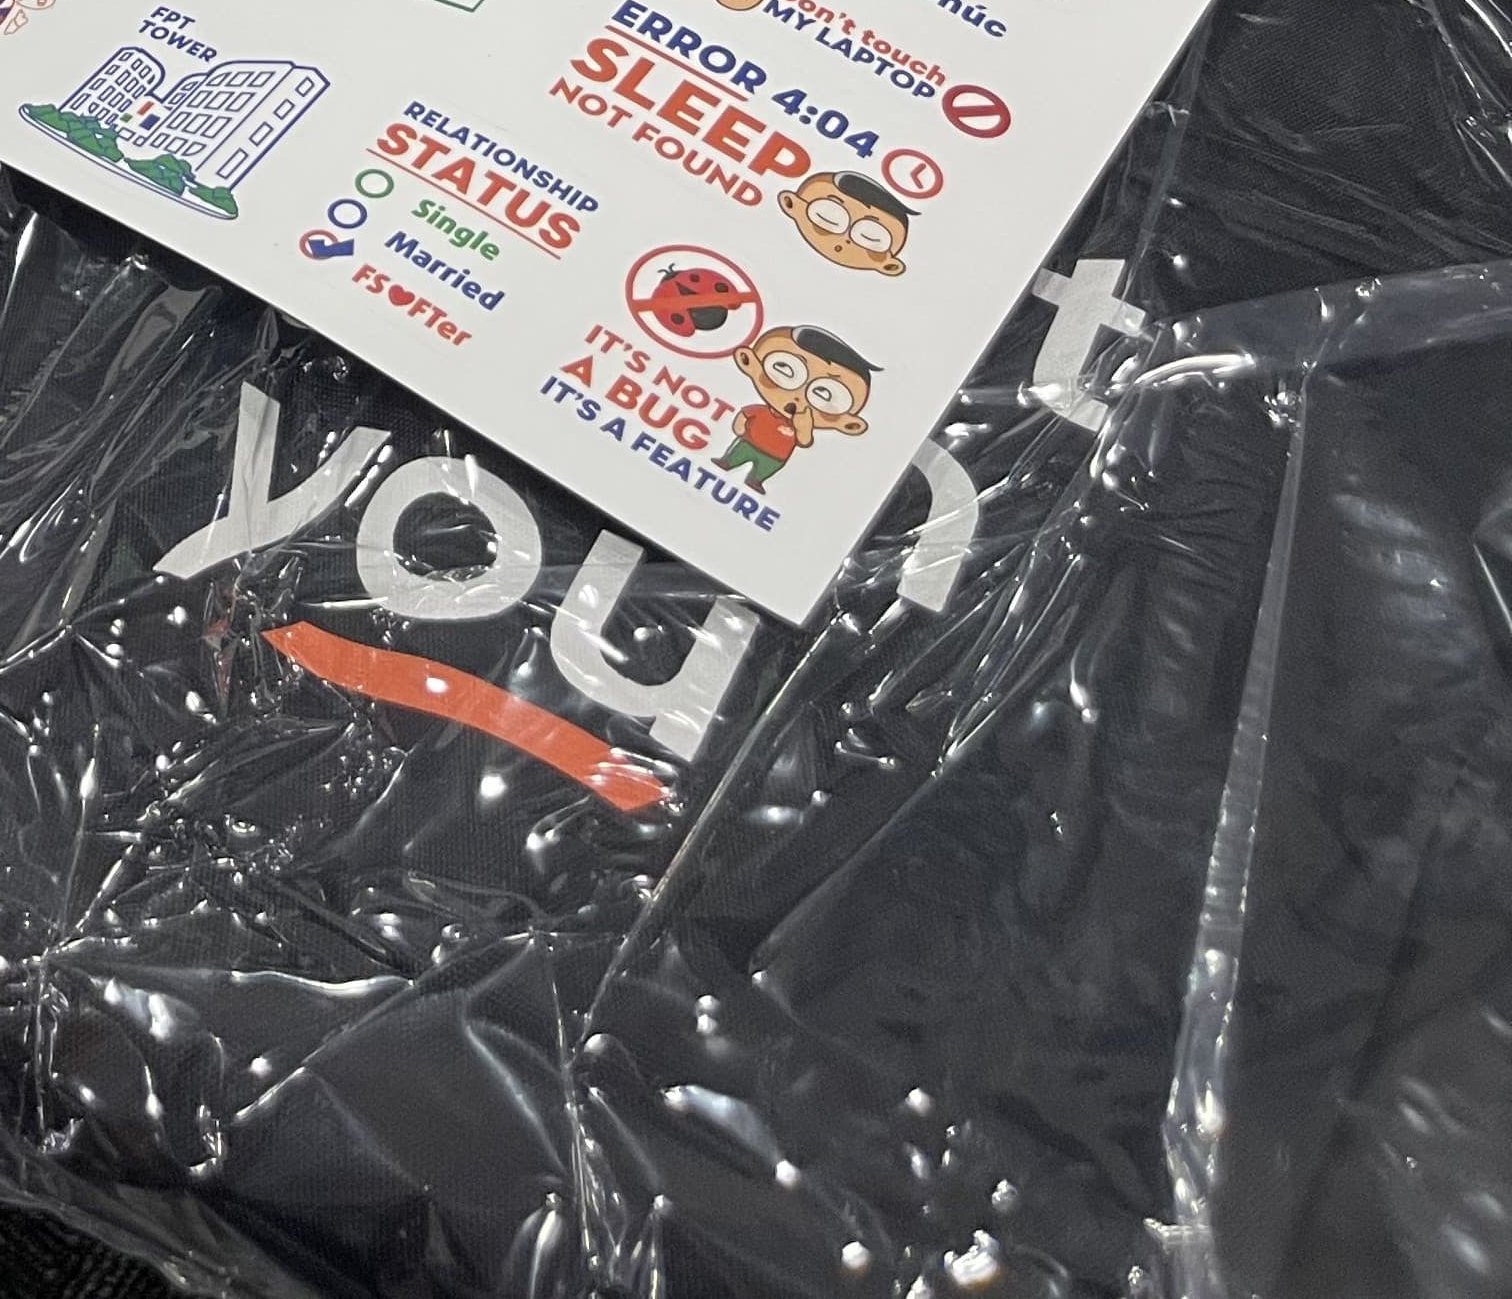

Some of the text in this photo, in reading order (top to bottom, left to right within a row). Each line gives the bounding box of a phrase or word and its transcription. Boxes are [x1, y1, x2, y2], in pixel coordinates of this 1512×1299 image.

[138, 20, 218, 63] TOWER
[150, 6, 196, 29] FPT
[815, 26, 936, 99] LAPTOP
[861, 28, 947, 87] touch
[548, 76, 763, 208] NOT FOUND
[570, 37, 812, 179] SLEEP
[771, 88, 880, 159] 4:04
[377, 123, 581, 250] STATUS
[403, 101, 599, 213] RELATIONSHIP
[384, 231, 505, 311] Married
[411, 198, 500, 261] Single
[560, 354, 712, 451] A BUG
[584, 324, 735, 422] IT'S NOT
[539, 375, 782, 532] IT'S A FEATURE
[152, 381, 760, 764] you
